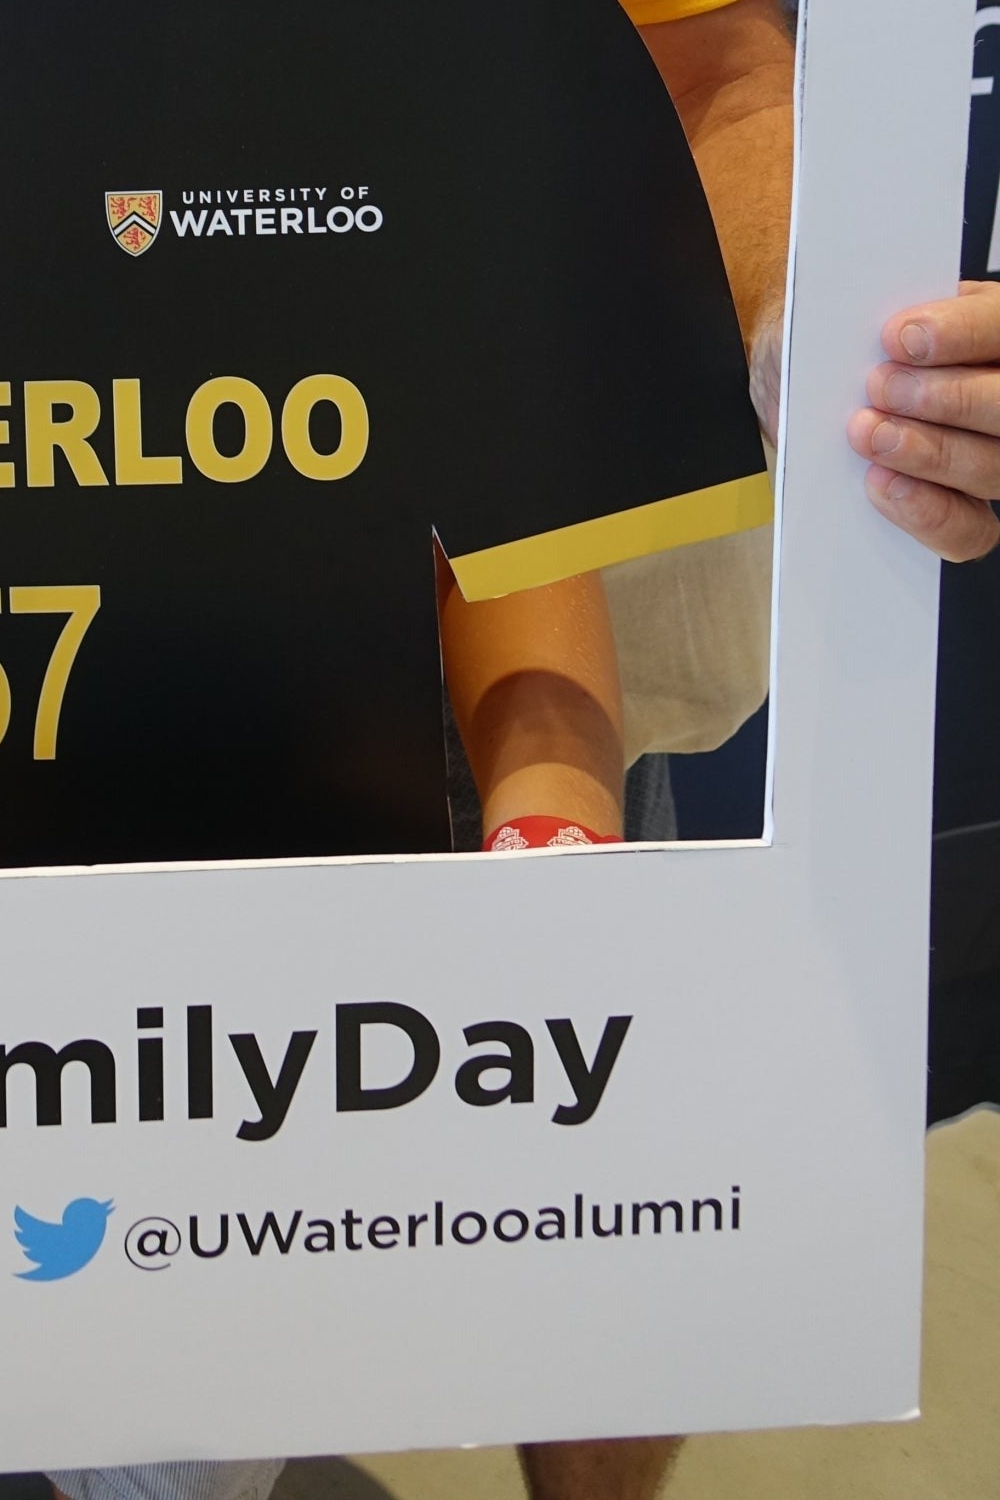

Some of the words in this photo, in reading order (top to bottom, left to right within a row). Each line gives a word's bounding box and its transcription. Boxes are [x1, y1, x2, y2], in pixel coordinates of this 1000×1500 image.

[182, 187, 327, 205] UNIVERSITY
[340, 186, 370, 200] OF
[169, 204, 384, 237] WATERLOO
[124, 1186, 742, 1271] @UWaterlooalumni
